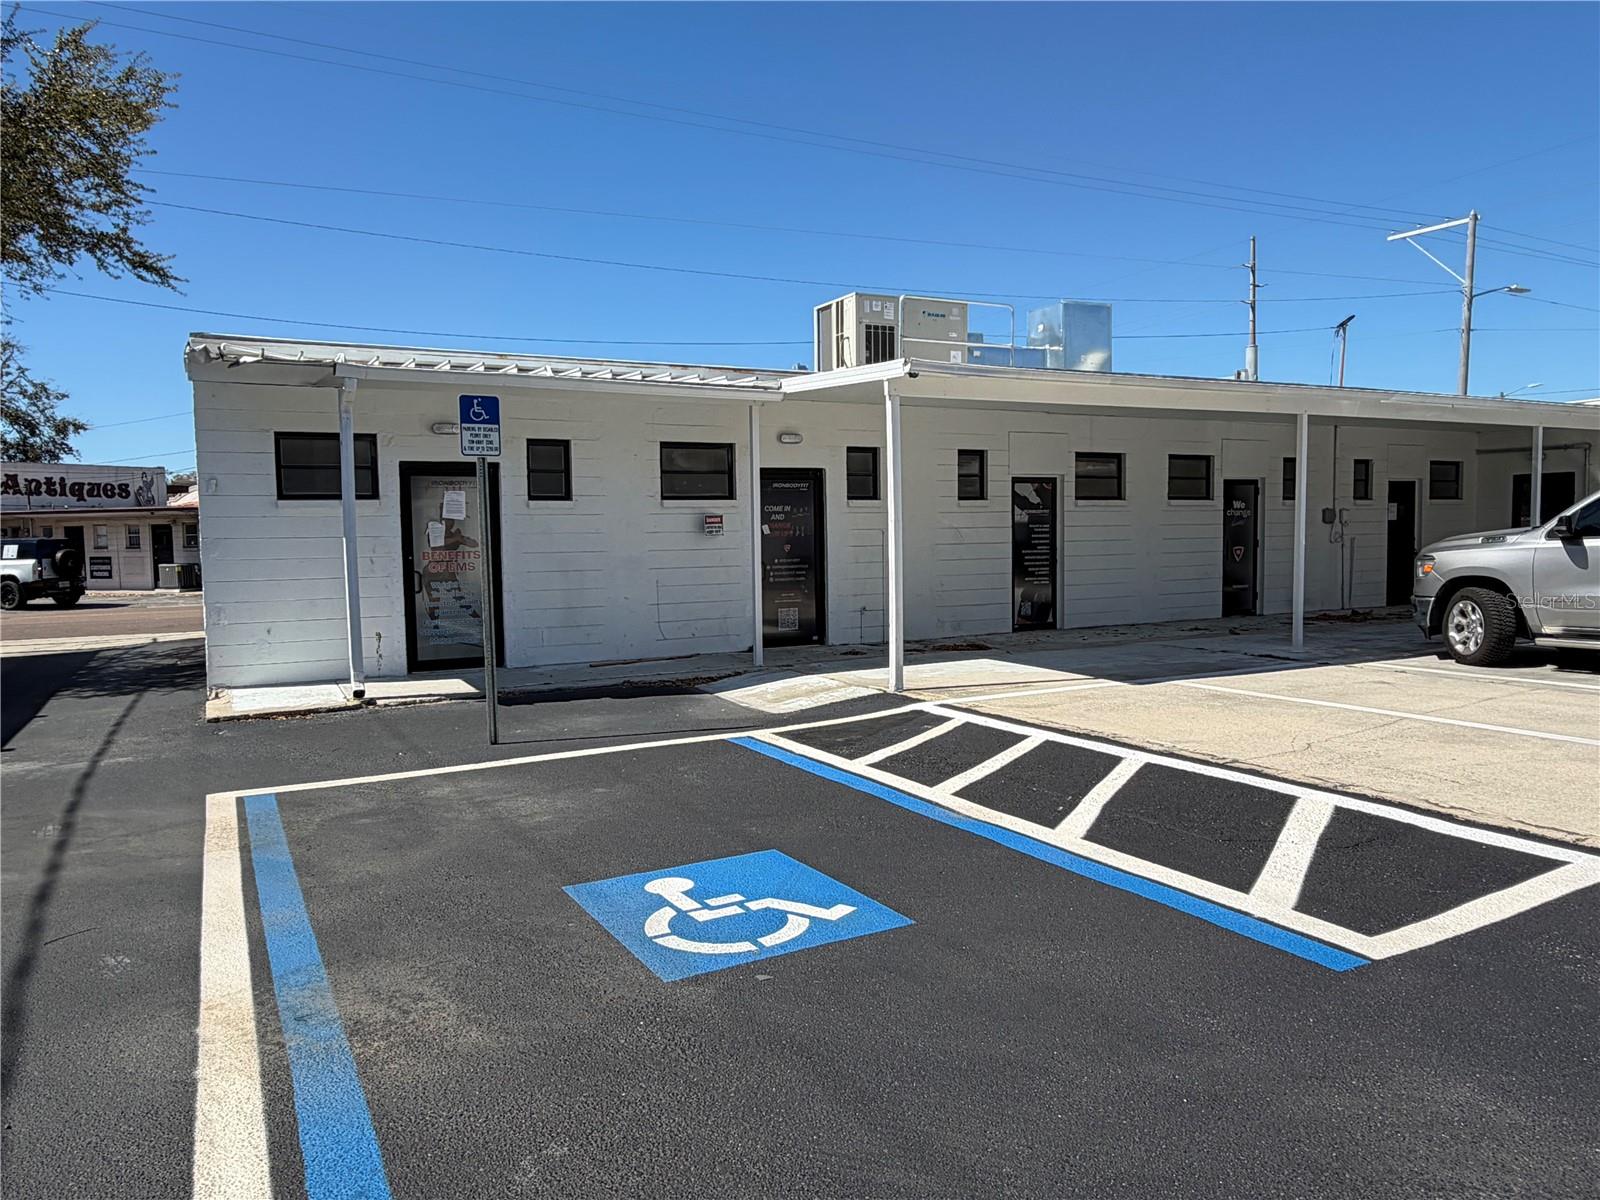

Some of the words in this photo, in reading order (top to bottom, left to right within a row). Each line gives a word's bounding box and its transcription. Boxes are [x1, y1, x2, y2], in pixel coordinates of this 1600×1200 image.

[1, 473, 131, 502] Antiques
[1232, 500, 1246, 509] We
[1226, 508, 1251, 518] change
[422, 551, 481, 561] BENEFITS
